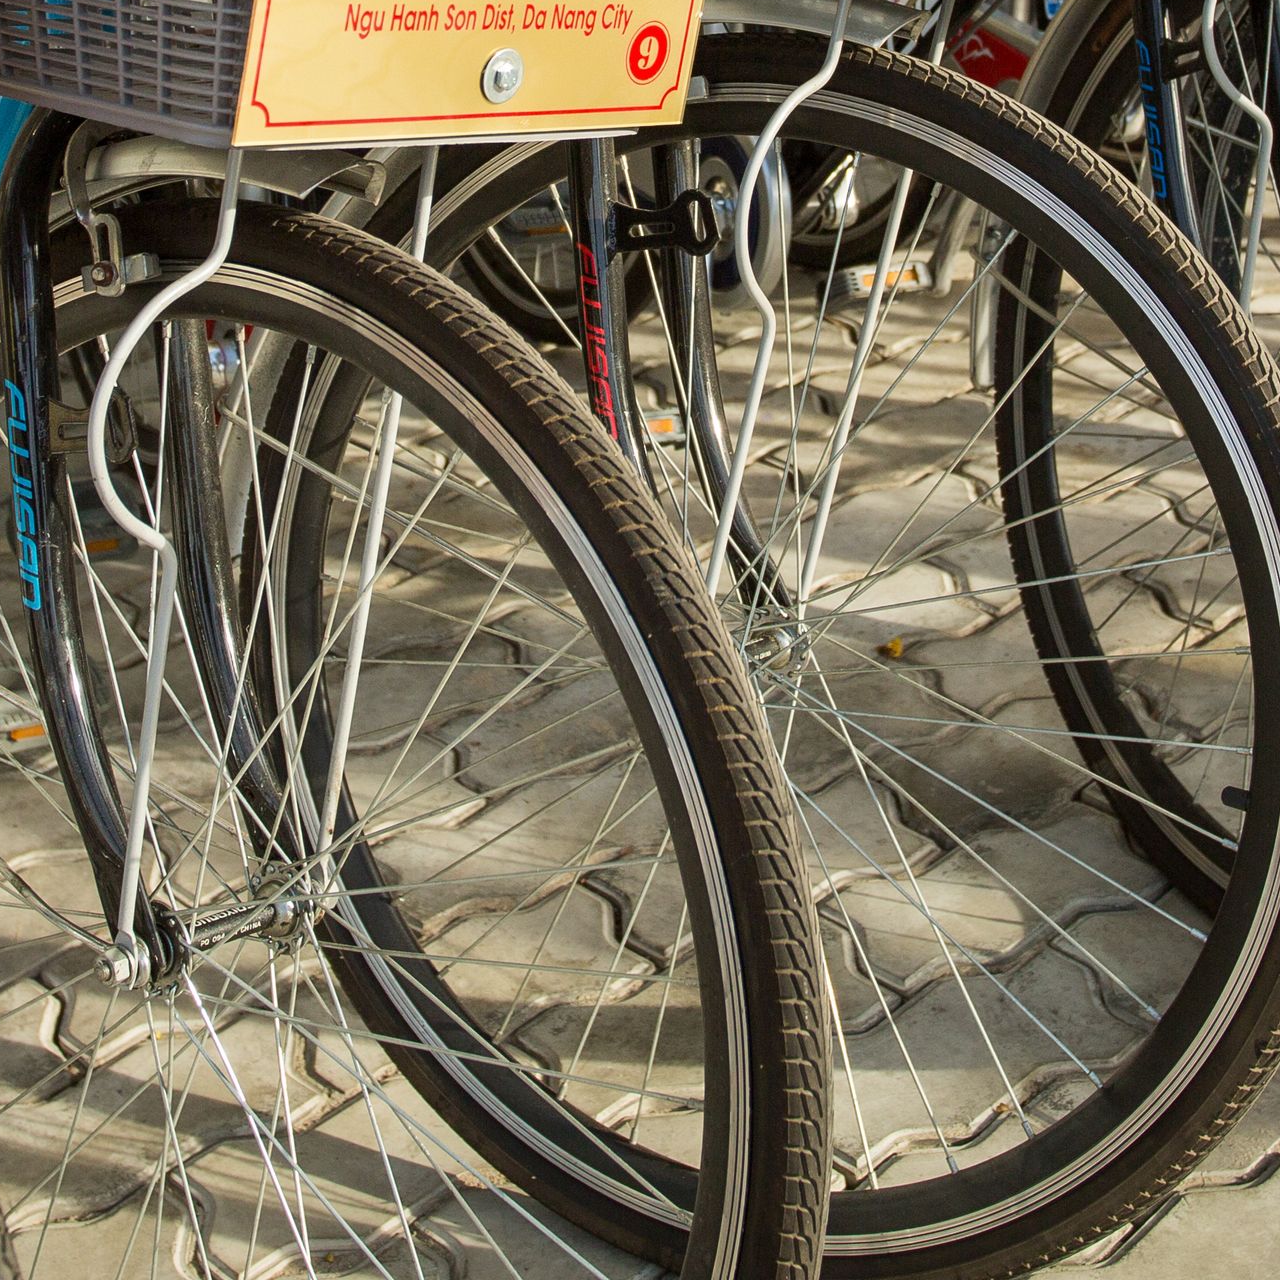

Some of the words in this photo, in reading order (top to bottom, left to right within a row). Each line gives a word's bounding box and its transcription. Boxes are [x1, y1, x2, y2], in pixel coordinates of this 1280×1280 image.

[345, 4, 385, 40] Ngu
[390, 4, 439, 31] Hanh
[444, 4, 477, 31] Son
[482, 4, 515, 32] Dist,
[522, 4, 547, 30] Da
[551, 4, 597, 37] Nang
[602, 4, 633, 34] City
[637, 35, 658, 71] 9
